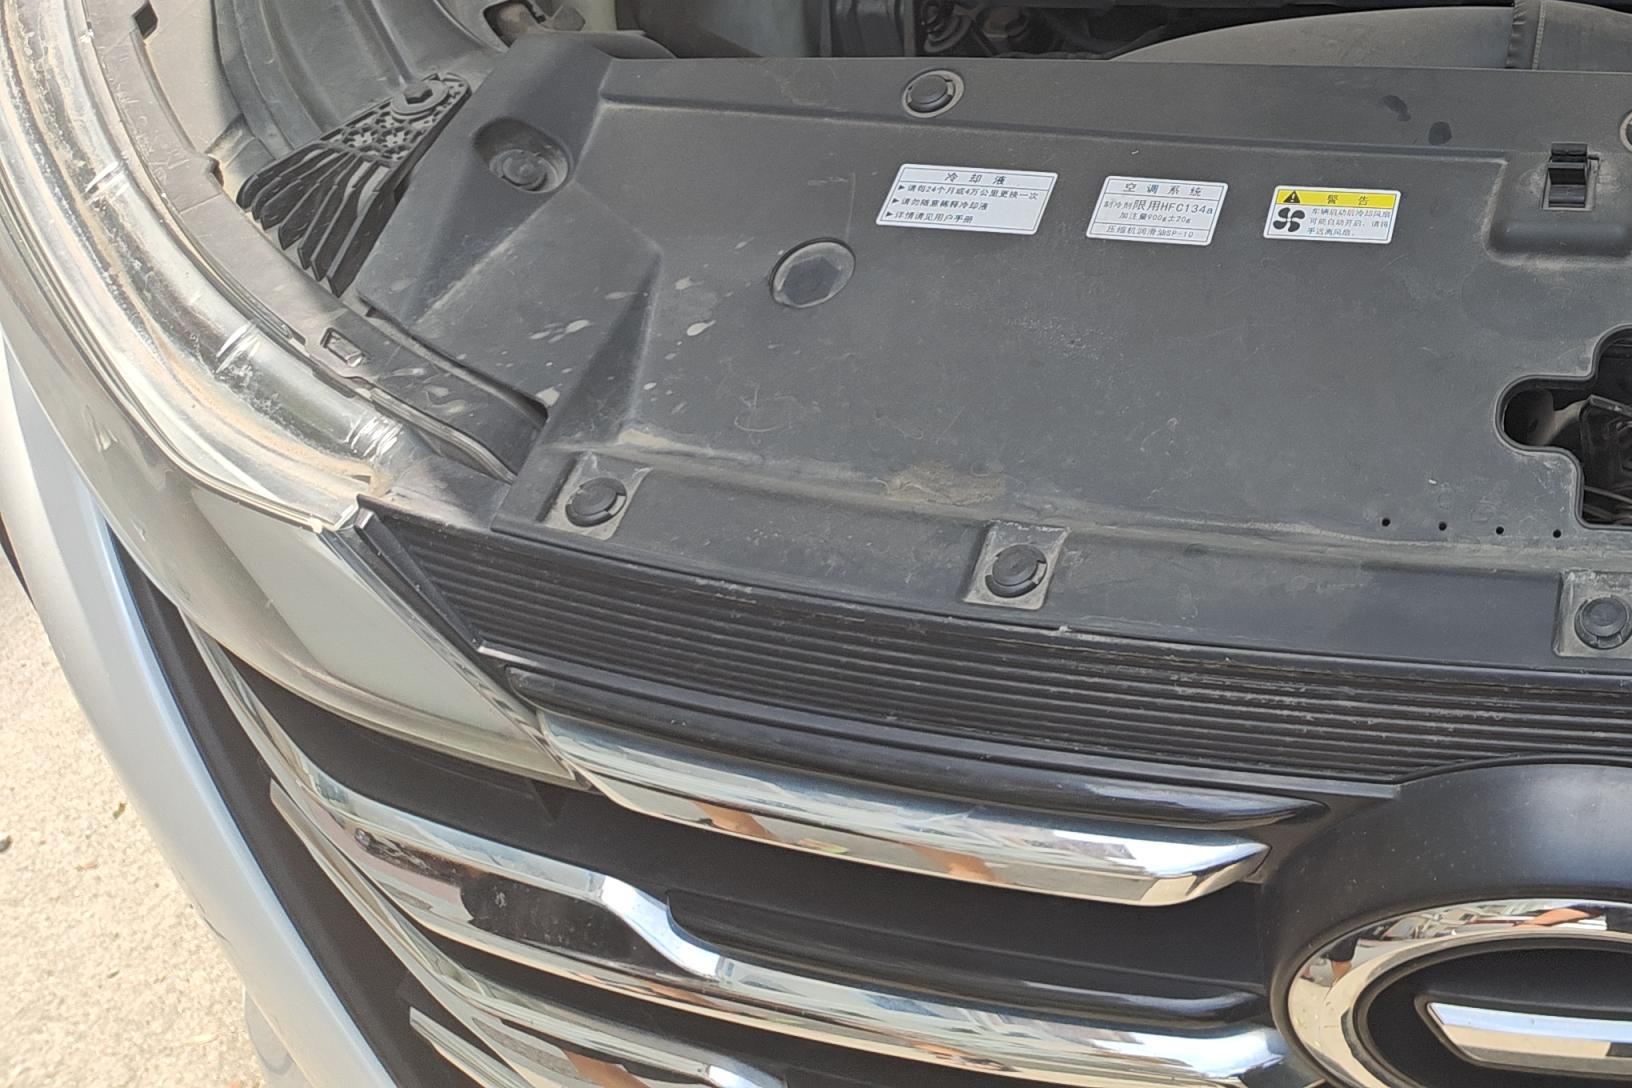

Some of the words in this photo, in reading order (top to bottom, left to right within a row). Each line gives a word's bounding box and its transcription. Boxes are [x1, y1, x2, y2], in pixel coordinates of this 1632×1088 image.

[944, 172, 1007, 185] 冷却液
[1123, 183, 1202, 197] 空调系统
[901, 198, 989, 210] 请勿随意稀释冷却液
[1327, 195, 1369, 205] 警告
[894, 211, 974, 224] 详情请见用户手册
